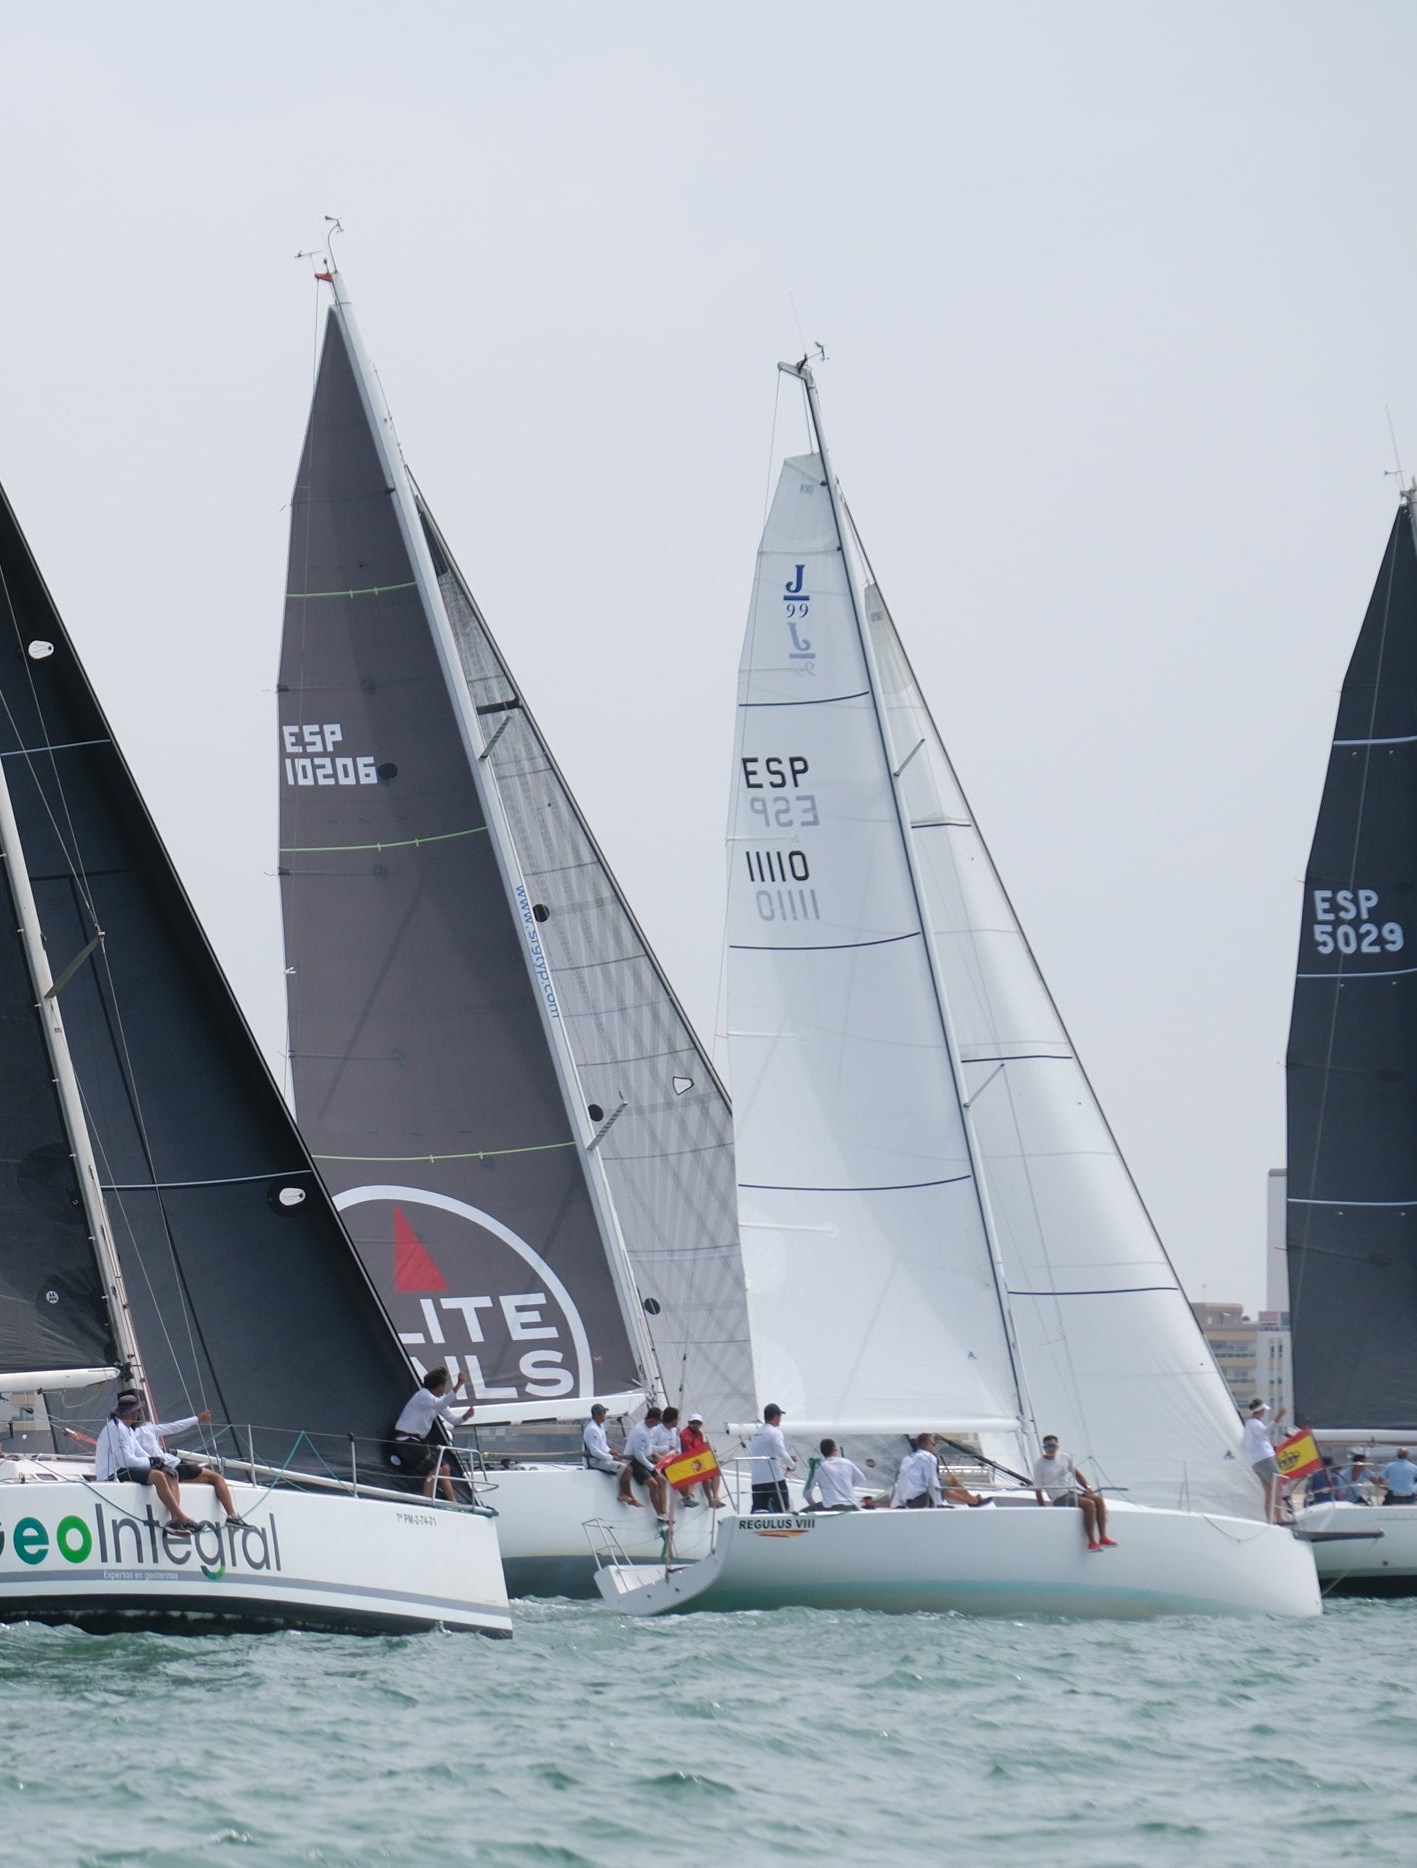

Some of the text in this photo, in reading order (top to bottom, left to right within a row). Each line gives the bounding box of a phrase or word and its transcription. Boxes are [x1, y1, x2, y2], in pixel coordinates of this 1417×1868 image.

[785, 564, 806, 594] J
[786, 603, 809, 618] 99
[282, 723, 343, 753] ESP
[284, 756, 378, 786] 10206
[741, 756, 809, 788] ESP
[745, 850, 810, 882] 11110
[1313, 889, 1379, 920] ESP
[1313, 922, 1405, 954] 5029
[739, 1519, 815, 1529] REGULUS VIII
